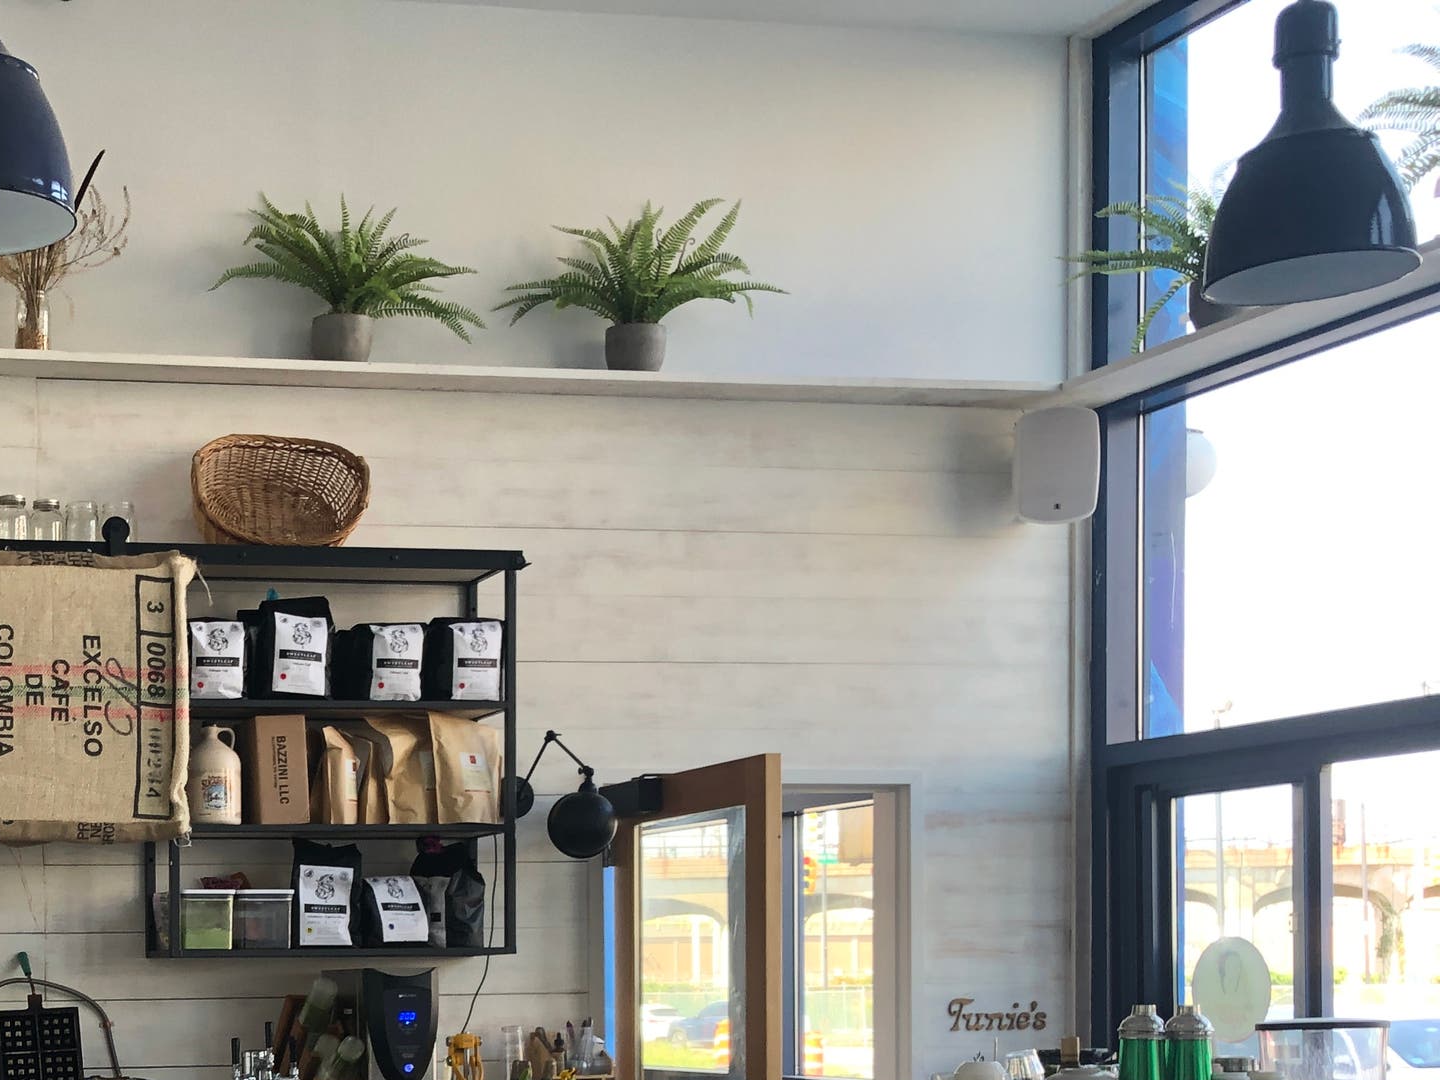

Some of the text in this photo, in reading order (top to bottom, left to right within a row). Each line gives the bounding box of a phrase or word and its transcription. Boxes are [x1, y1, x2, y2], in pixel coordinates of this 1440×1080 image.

[146, 600, 167, 699] 3 0068
[25, 674, 43, 706] DE
[83, 634, 103, 757] EXCELSO
[276, 735, 291, 805] BAZZINI LLC
[947, 998, 1048, 1031] Tunie's
